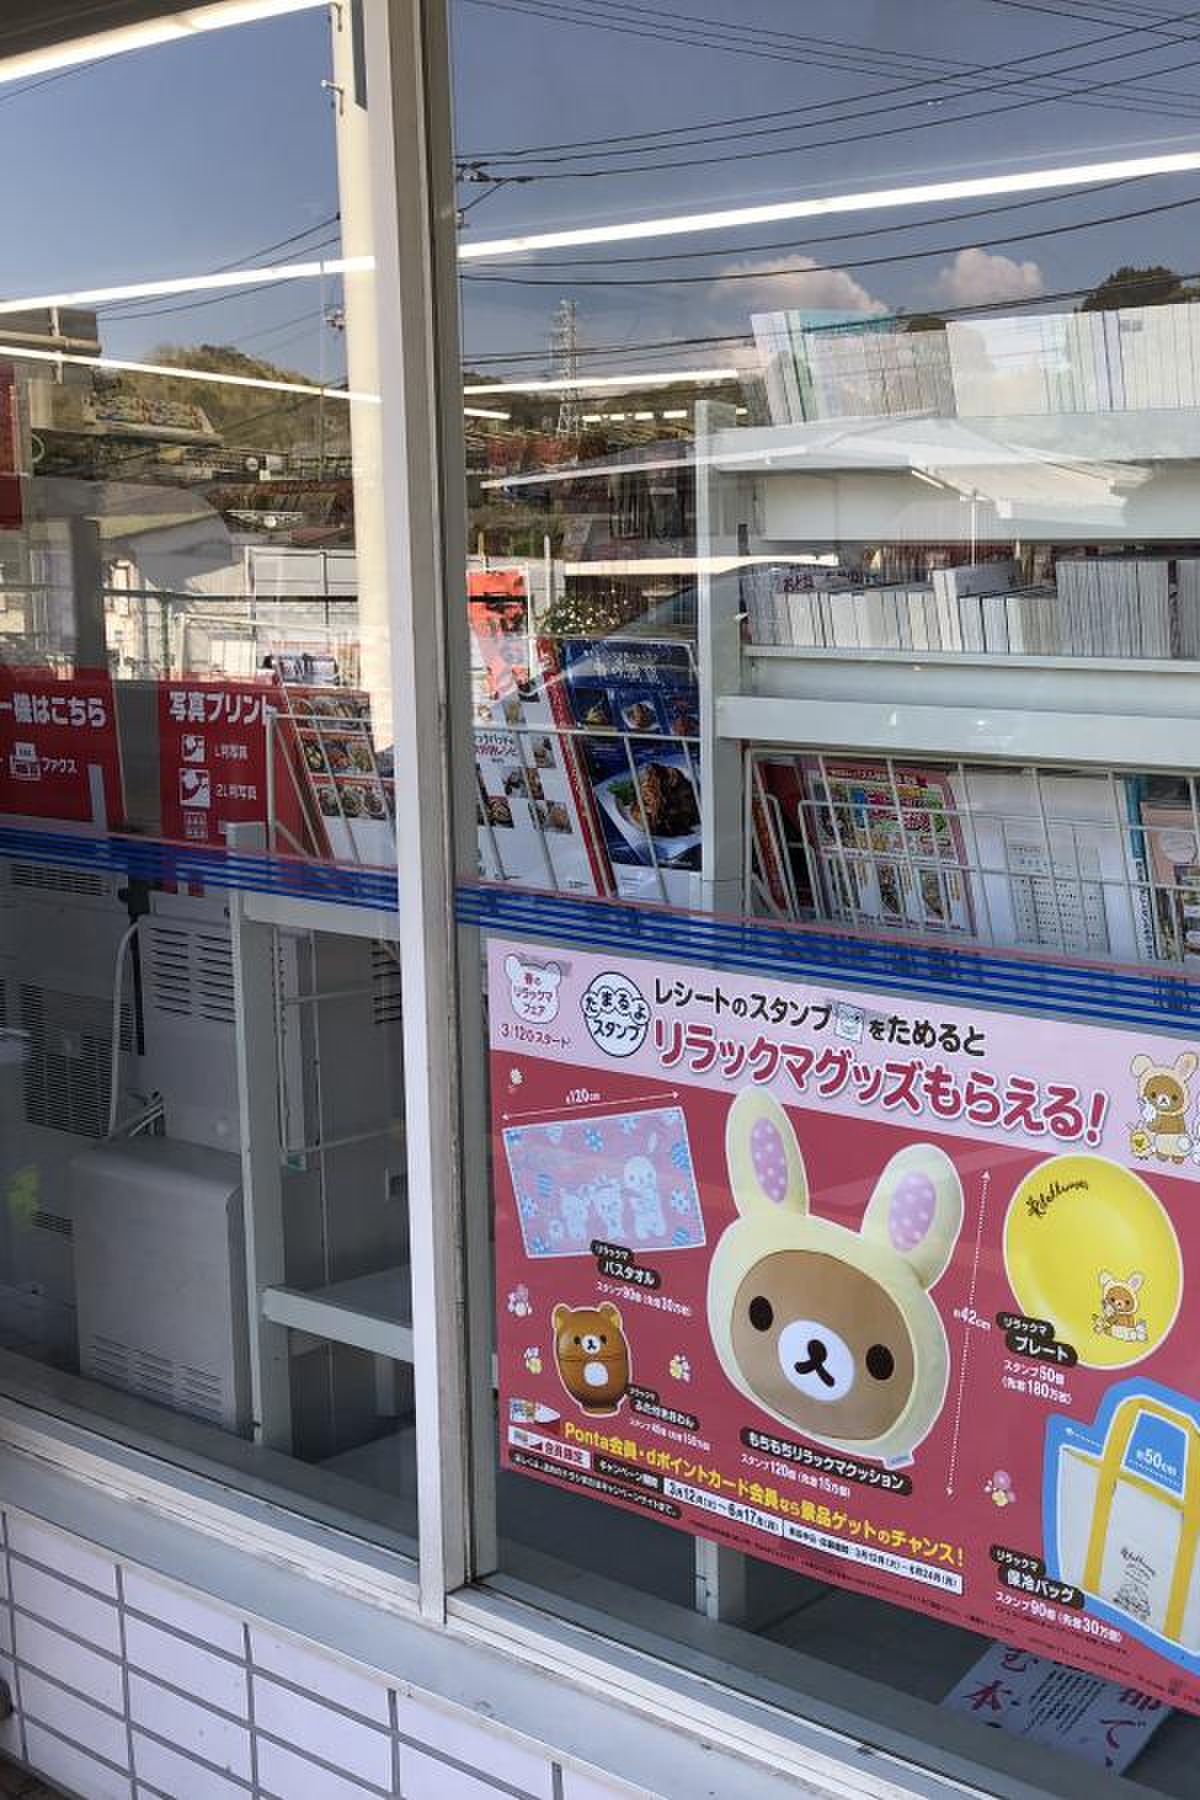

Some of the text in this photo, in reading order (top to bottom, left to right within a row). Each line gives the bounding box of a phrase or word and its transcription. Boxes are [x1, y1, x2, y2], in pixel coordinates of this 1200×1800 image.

[168, 691, 278, 725] 写真プリント
[593, 1018, 639, 1042] スタンプ
[655, 977, 986, 1057] レシートのスタンプ をためると
[654, 1016, 1109, 1148] リラックマグッズもらえる!
[1003, 1316, 1048, 1336] リラックマ
[1015, 1335, 1070, 1361] プレート
[748, 1430, 904, 1490] もちもちリラックマクッション
